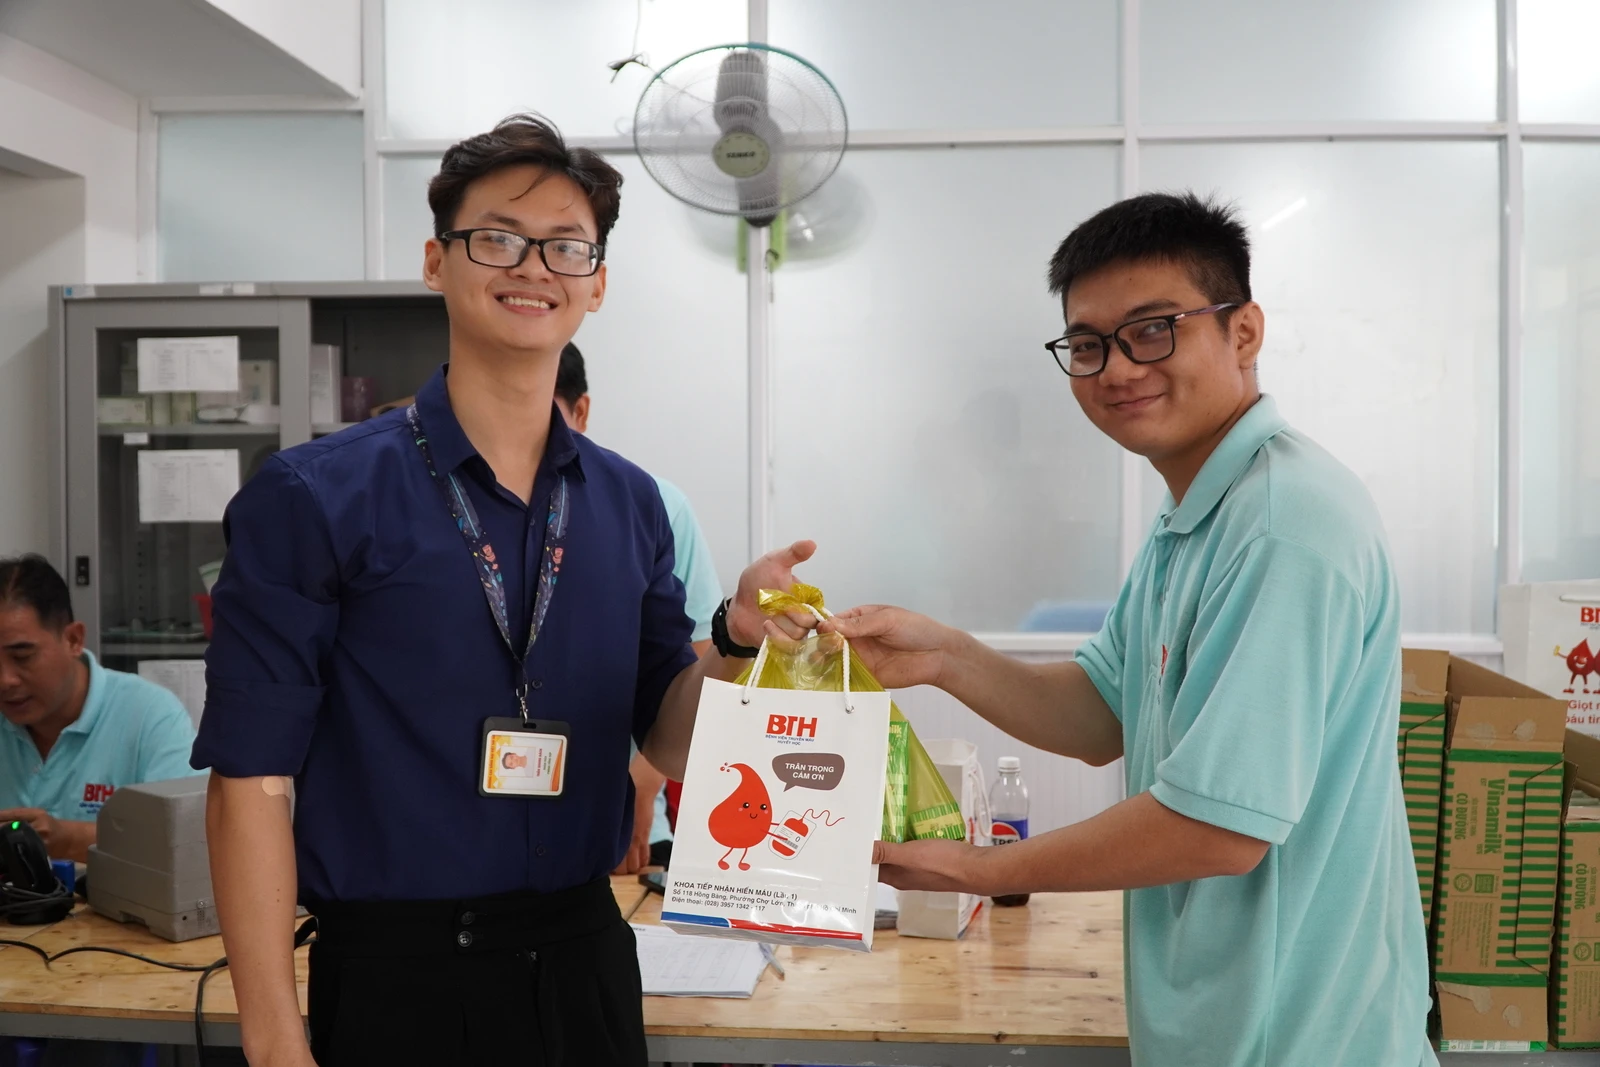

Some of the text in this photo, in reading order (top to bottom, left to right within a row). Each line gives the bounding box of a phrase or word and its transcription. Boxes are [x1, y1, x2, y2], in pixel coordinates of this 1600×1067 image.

[1581, 606, 1600, 623] BT
[1568, 699, 1593, 712] Giọt
[766, 714, 818, 738] BTH
[808, 765, 834, 773] TRỌNG
[1484, 778, 1505, 854] Vinamilk
[674, 881, 695, 889] KHOA
[697, 882, 712, 890] TIẾP
[736, 886, 754, 895] HIẾN
[755, 888, 772, 897] MÁU
